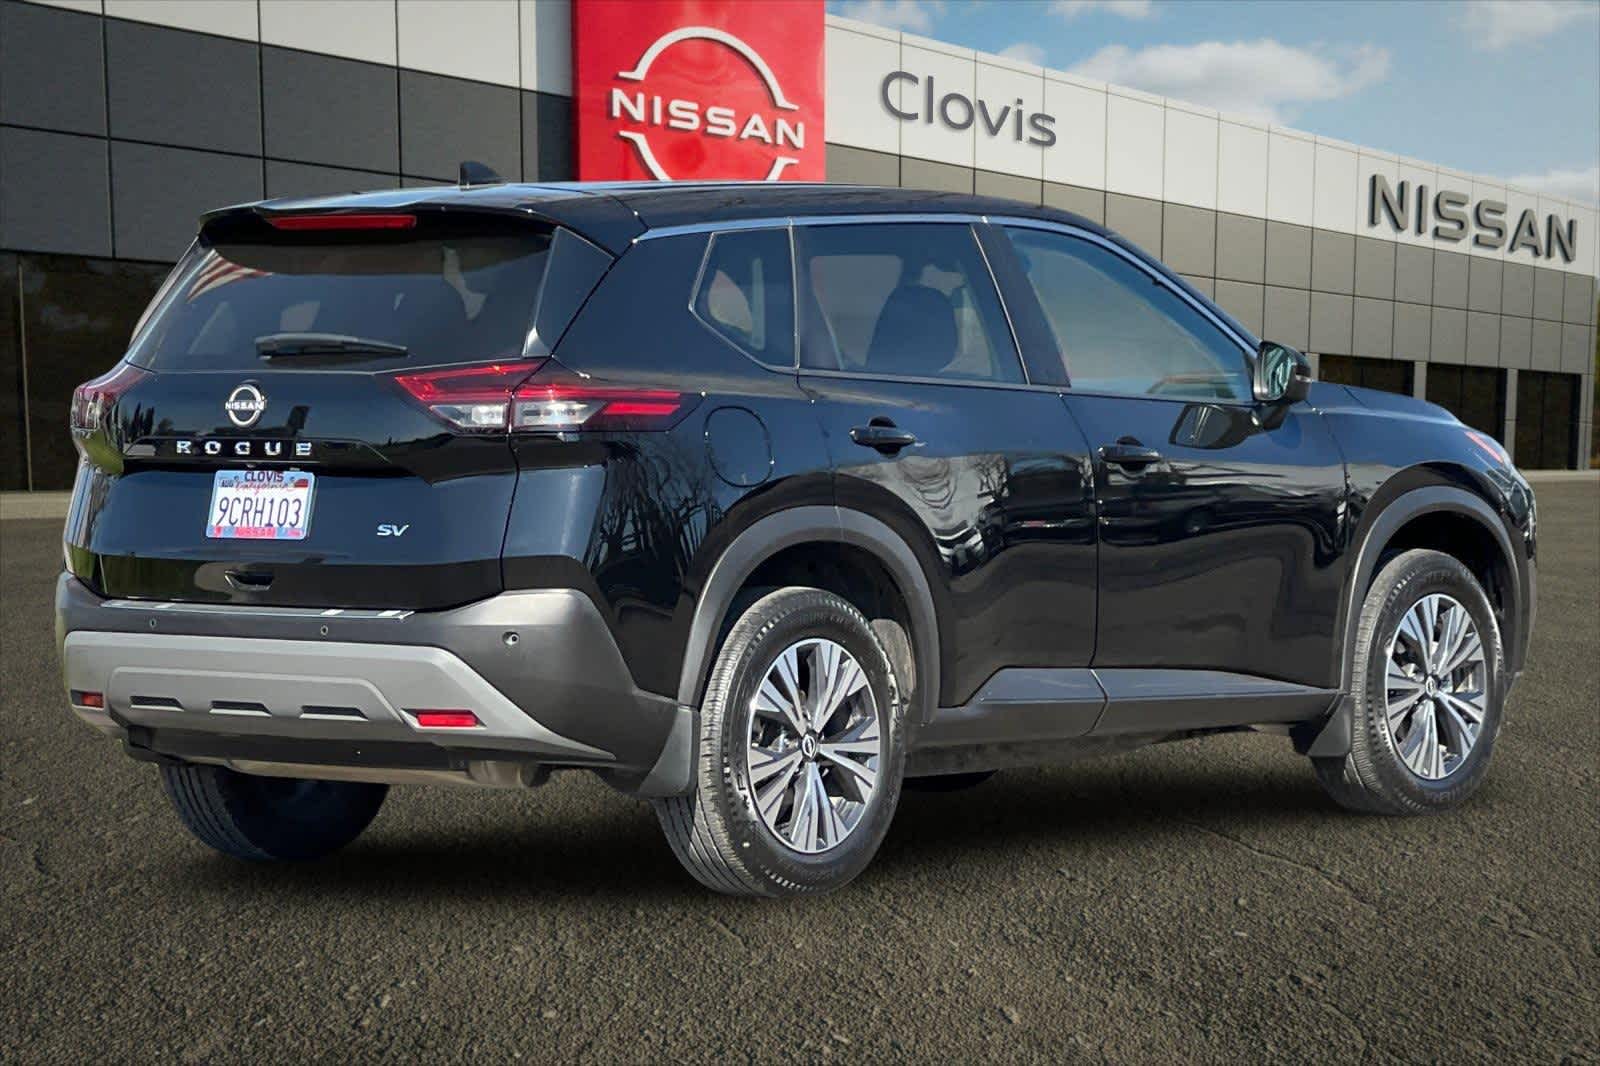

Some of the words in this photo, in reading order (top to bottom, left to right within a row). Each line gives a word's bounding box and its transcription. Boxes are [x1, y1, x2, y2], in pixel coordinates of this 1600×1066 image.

[611, 87, 806, 149] NISSAN
[881, 70, 1057, 147] Clovis
[1368, 173, 1578, 263] NISSAN
[225, 401, 265, 410] NISSAN
[176, 440, 312, 456] ROGUE
[244, 471, 284, 482] CLOVIS
[216, 497, 302, 527] 9CRH103
[377, 524, 409, 537] SV
